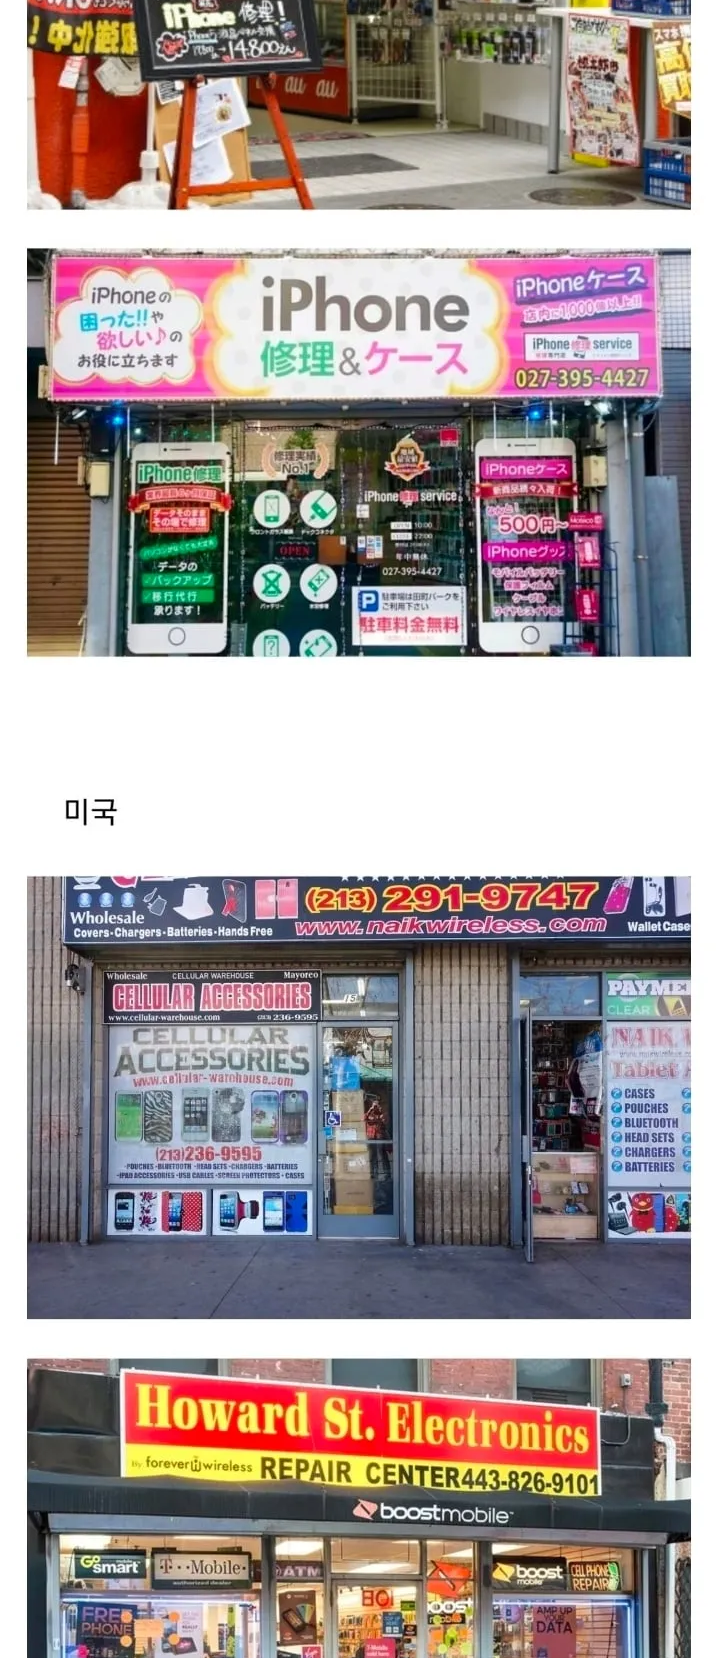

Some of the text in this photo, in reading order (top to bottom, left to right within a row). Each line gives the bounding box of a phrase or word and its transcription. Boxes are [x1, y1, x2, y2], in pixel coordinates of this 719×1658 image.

[515, 266, 645, 299] iPhoneケース
[91, 287, 172, 305] iPhoneの
[261, 276, 469, 332] iPhone
[78, 354, 178, 368] お役に立ちます
[515, 368, 649, 389] 027-395-4427
[282, 462, 310, 475] No.1
[485, 462, 568, 476] iPhoneケース
[382, 567, 442, 576] 027-395-4427
[360, 616, 459, 634] 駐車料金無料
[305, 882, 599, 913] (213) 291-9747
[70, 911, 145, 926] Wholesale
[107, 971, 318, 981] Wholesale CELLULAR WAREHOUSE Mayoreo
[112, 982, 312, 1012] CELLULAR ACCESSORIES
[108, 1013, 220, 1022] www.cellular-warehouse.com
[132, 1027, 289, 1045] CELLULAR
[113, 1046, 311, 1077] ACCESSORIES
[624, 1103, 669, 1114] POUCHES
[624, 1117, 679, 1128] BLUETOOTH
[624, 1162, 675, 1172] BATTERIES
[135, 1383, 589, 1454] Howard St. Electronics
[260, 1456, 599, 1495] REPAIR CENTER 443-826-9101
[516, 1564, 564, 1580] boost
[536, 1621, 573, 1634] DATA
